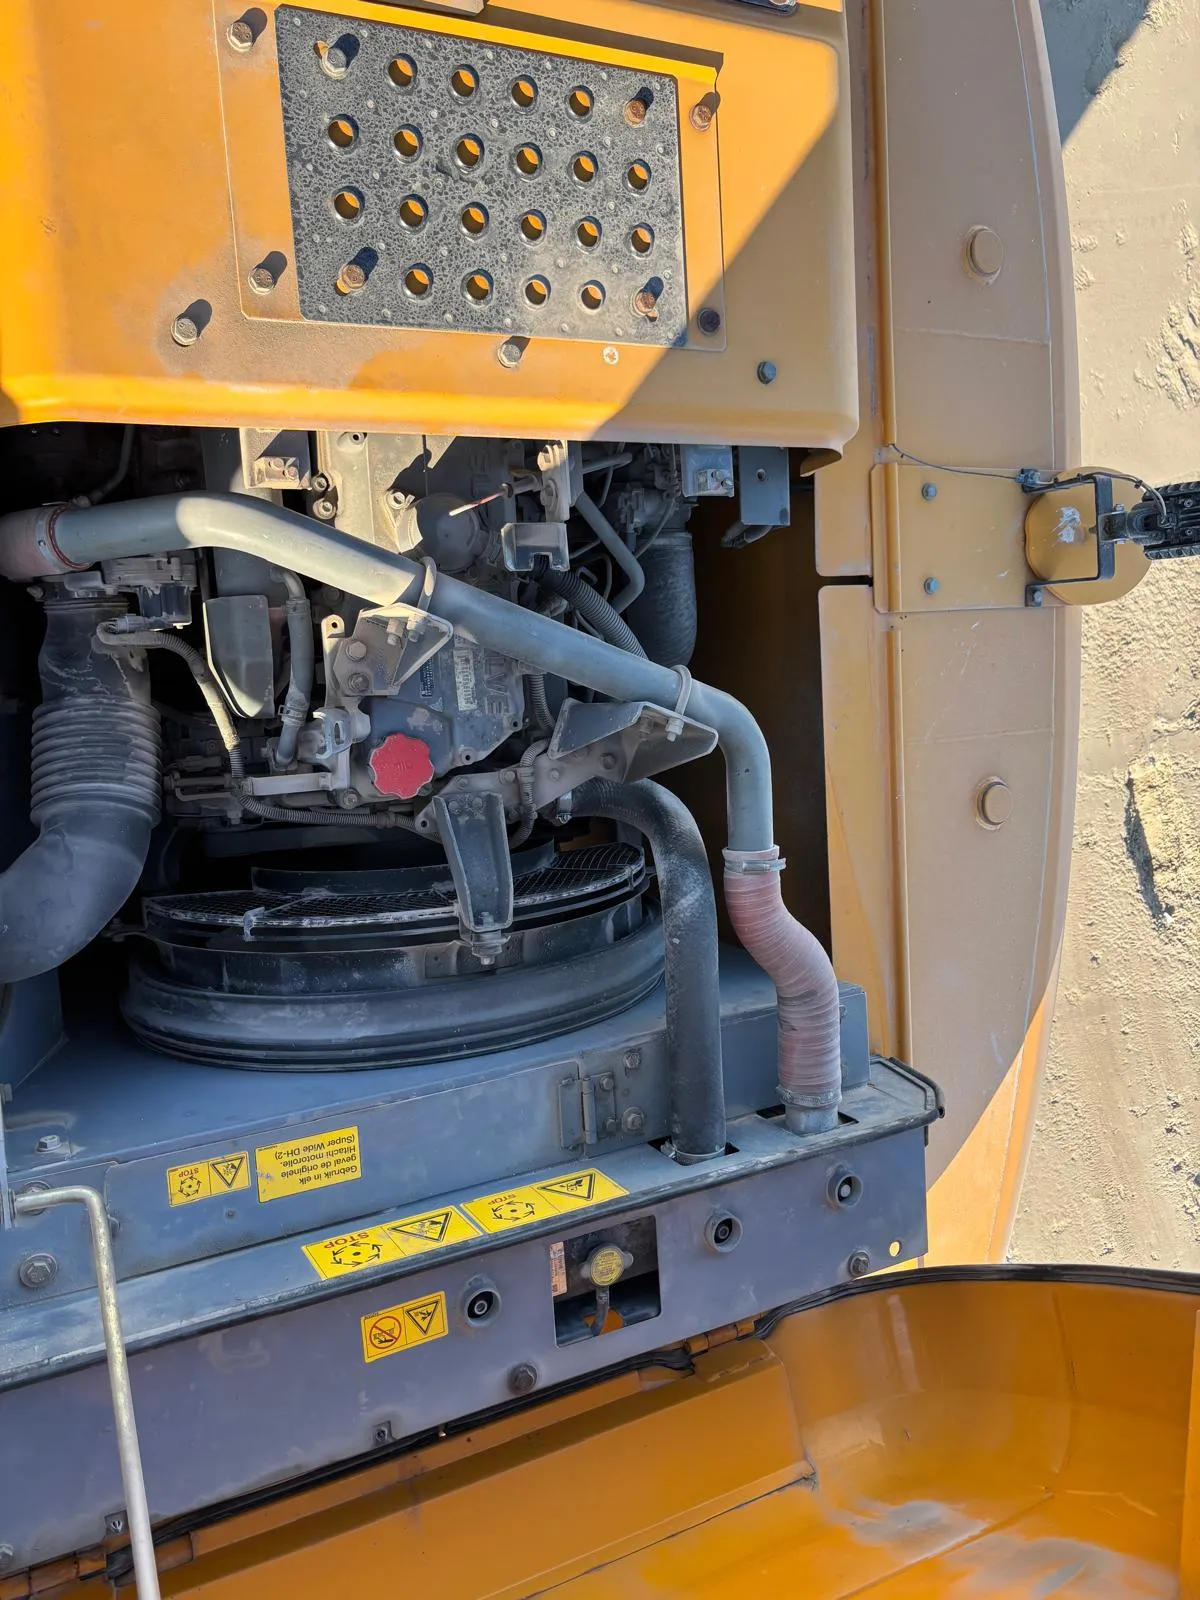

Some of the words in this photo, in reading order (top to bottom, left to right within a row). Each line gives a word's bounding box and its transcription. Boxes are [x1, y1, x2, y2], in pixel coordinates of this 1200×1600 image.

[327, 1134, 355, 1147] (Super
[274, 1148, 300, 1160] DH-2)
[303, 1142, 325, 1153] Wide
[326, 1145, 355, 1159] Hitachi
[280, 1153, 324, 1167] motorolie.
[320, 1162, 331, 1170] de
[334, 1153, 357, 1167] geval
[178, 1167, 199, 1178] STOP
[281, 1163, 318, 1178] originele
[324, 1165, 357, 1178] Gebruik
[299, 1175, 312, 1184] elk
[487, 1193, 517, 1205] STOP
[323, 1232, 369, 1249] STOP
